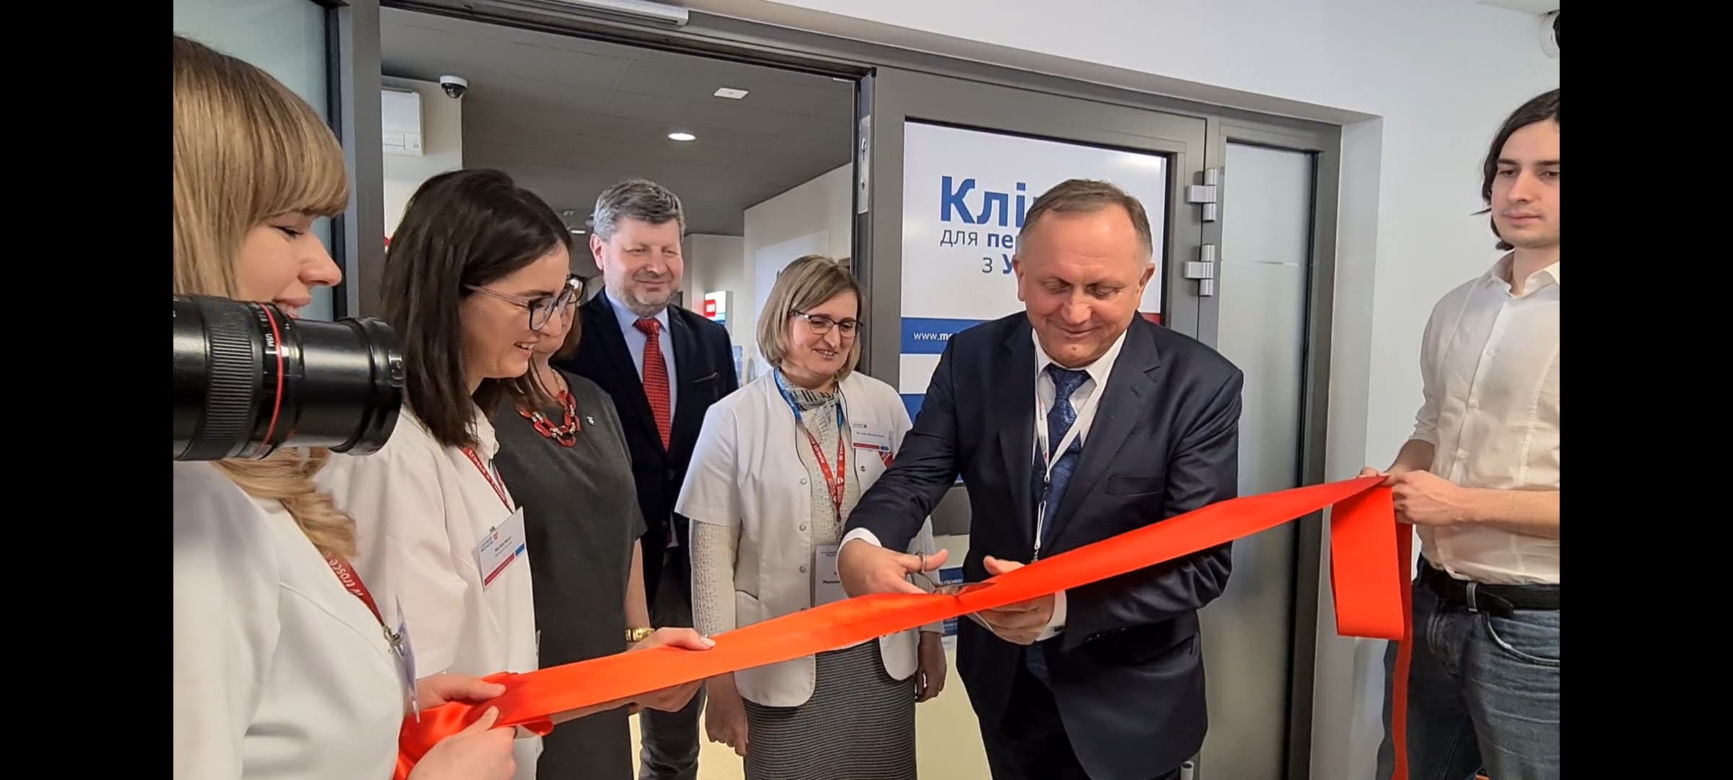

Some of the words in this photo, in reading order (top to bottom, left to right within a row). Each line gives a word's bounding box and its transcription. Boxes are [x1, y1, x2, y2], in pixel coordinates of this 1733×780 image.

[940, 175, 1040, 228] Клі
[940, 229, 978, 247] для
[987, 233, 1018, 249] пе
